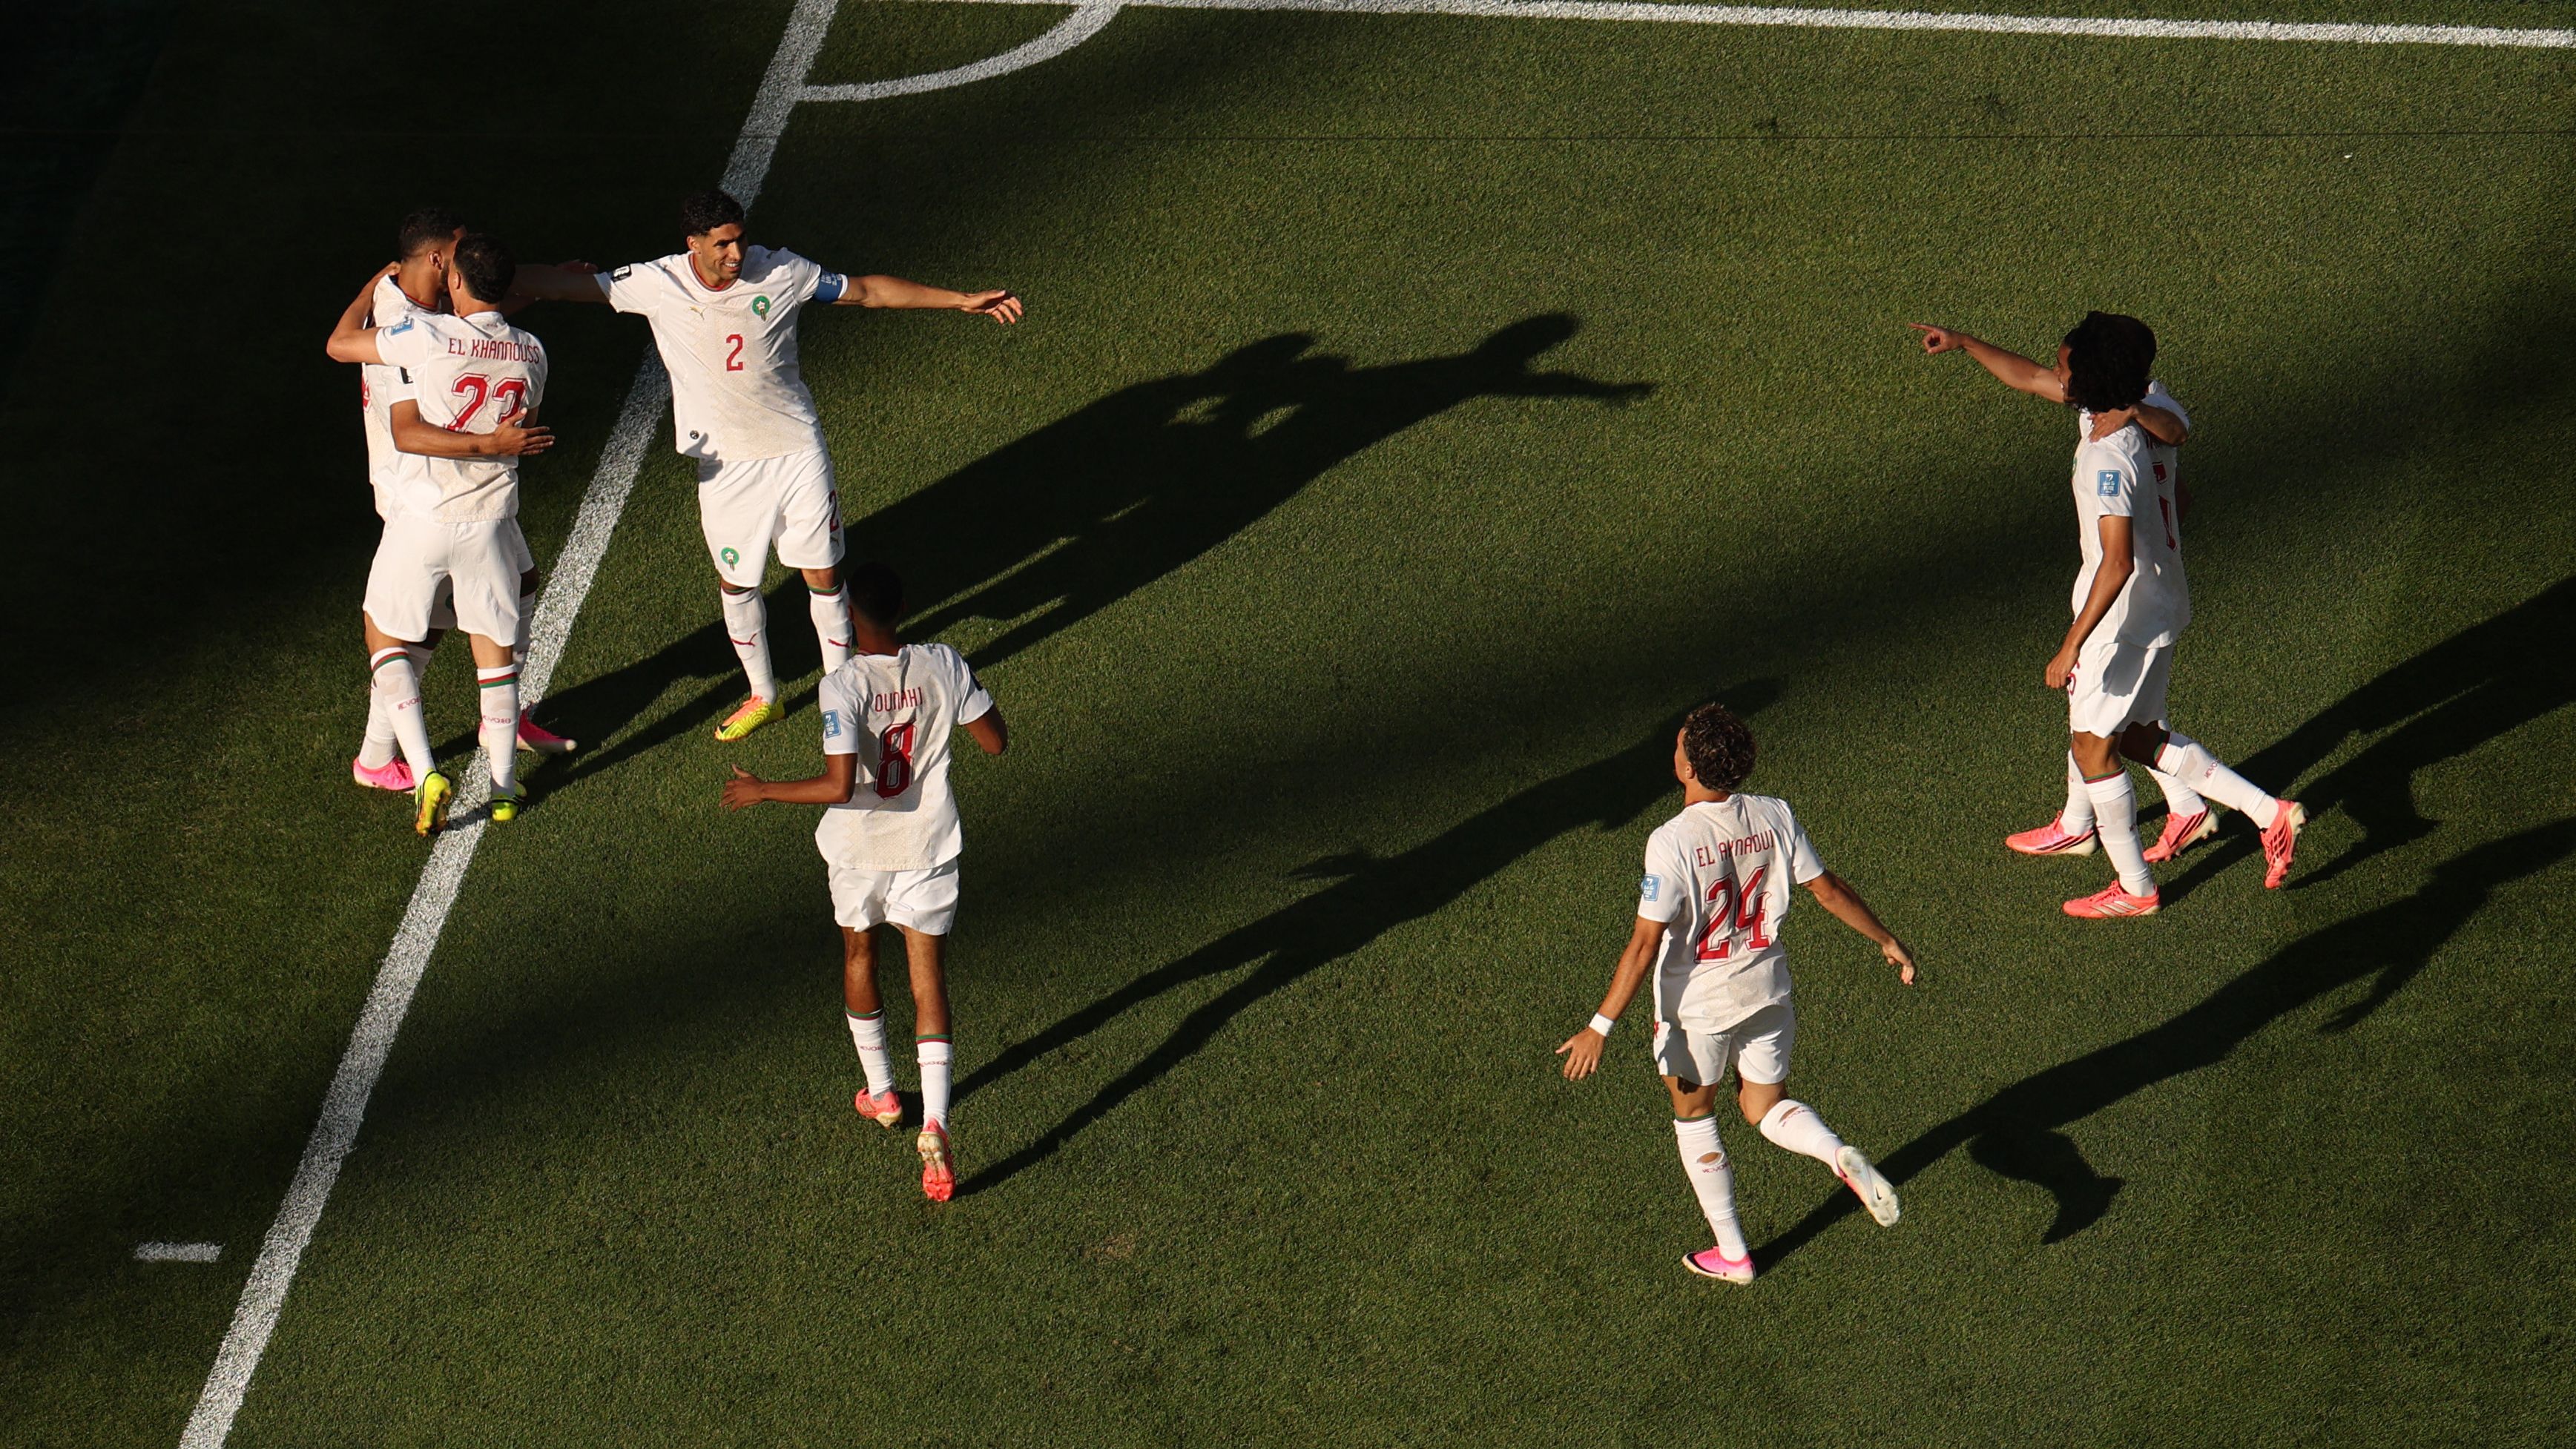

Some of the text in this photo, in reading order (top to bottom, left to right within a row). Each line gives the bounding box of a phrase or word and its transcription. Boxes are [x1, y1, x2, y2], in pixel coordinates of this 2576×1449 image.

[448, 337, 540, 364] EL KHANNOUSS
[725, 333, 744, 372] 2
[873, 720, 918, 801] 8
[1696, 847, 1716, 868] EL
[1693, 863, 1772, 965] 24
